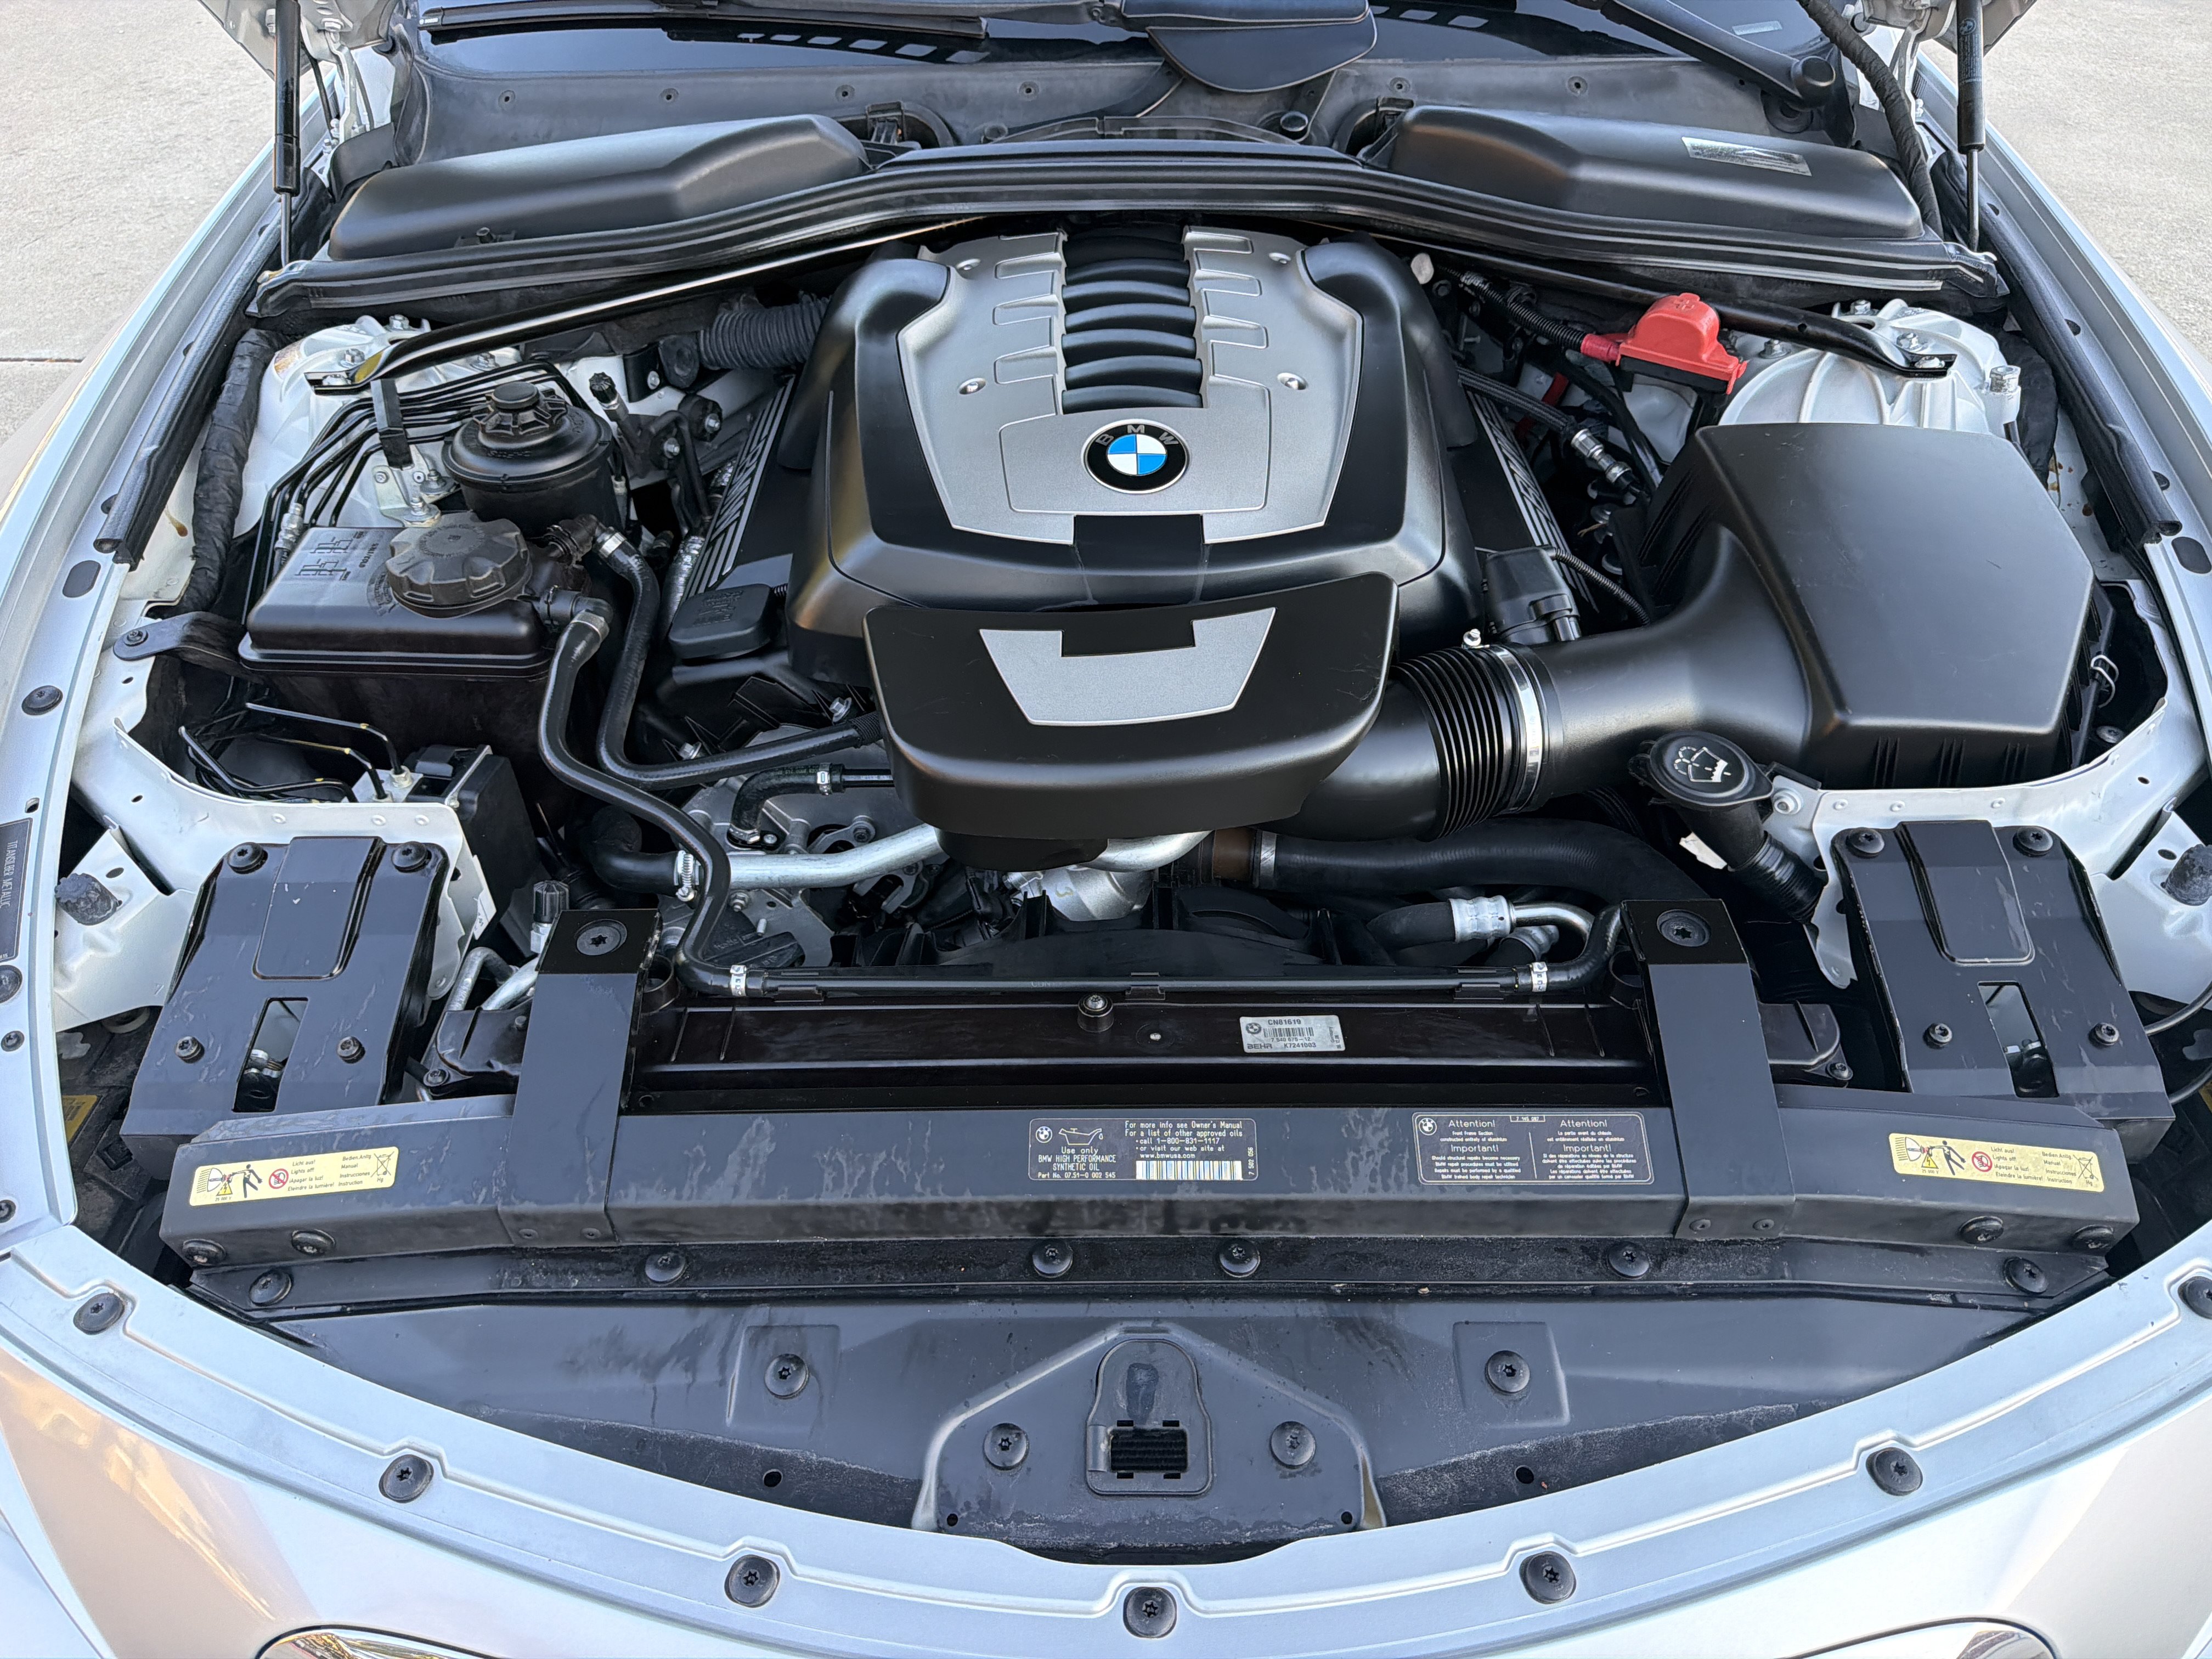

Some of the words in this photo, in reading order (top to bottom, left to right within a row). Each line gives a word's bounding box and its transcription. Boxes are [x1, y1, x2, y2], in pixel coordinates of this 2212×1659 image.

[1096, 425, 1179, 446] BMW
[3, 839, 18, 877] TITANSILBER
[1560, 1119, 1607, 1127] Attention!
[1197, 1129, 1226, 1137] approved
[1081, 1146, 1098, 1155] only
[1451, 1144, 1499, 1153] Important!
[1564, 1144, 1611, 1153] Important!
